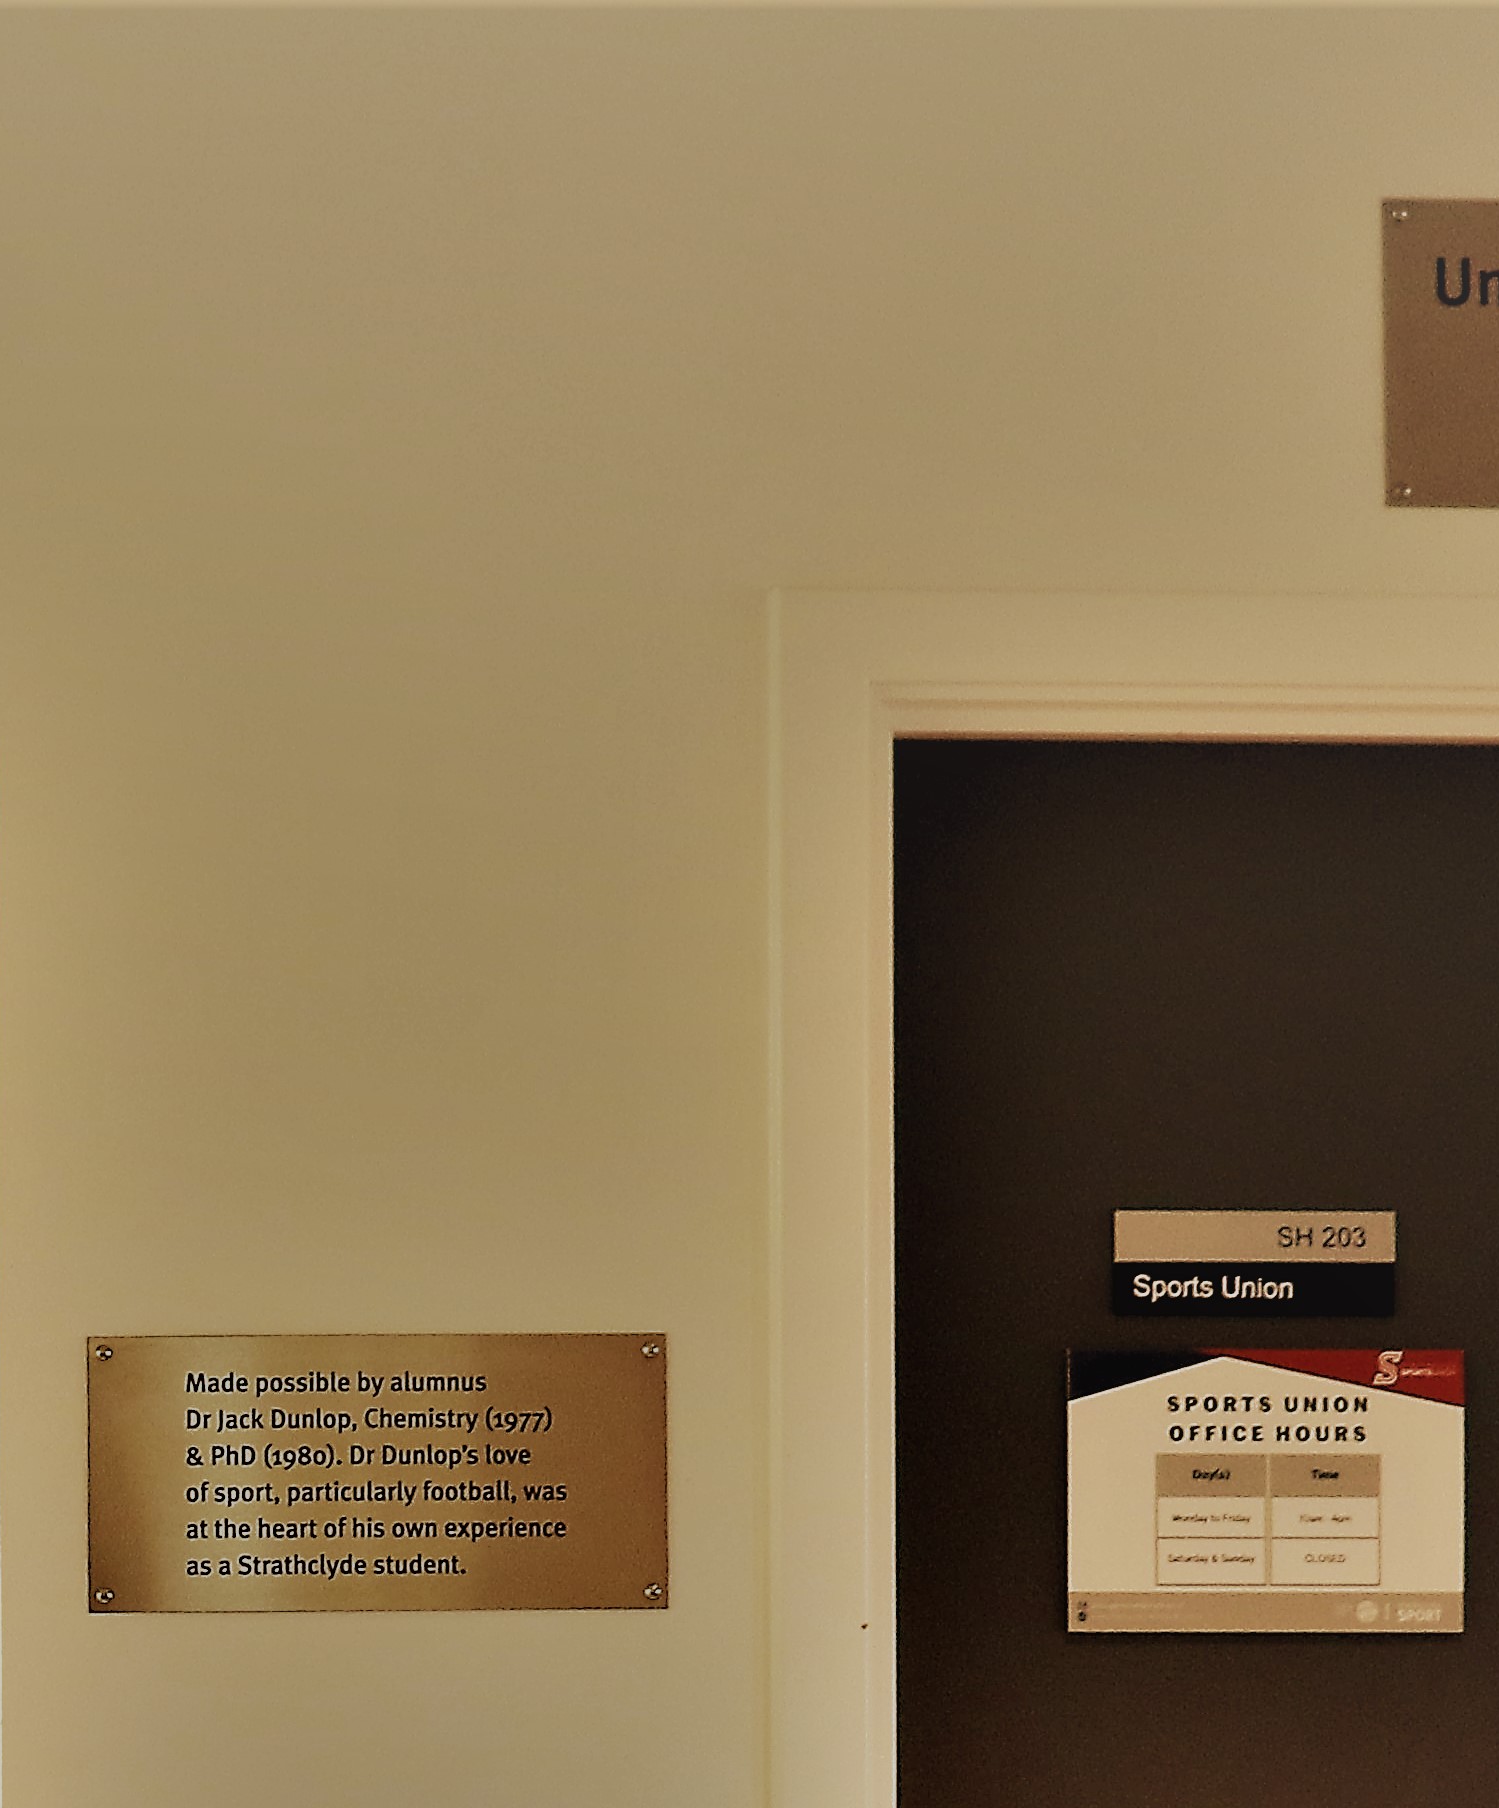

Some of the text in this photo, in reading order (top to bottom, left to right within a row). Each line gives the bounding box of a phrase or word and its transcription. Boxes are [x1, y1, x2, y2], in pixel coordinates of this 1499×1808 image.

[1278, 1227, 1365, 1247] SH 203
[1134, 1274, 1293, 1302] Sports Union
[186, 1371, 486, 1397] Made possible by alumnus
[1168, 1396, 1367, 1412] SPORTS UNION
[187, 1406, 552, 1434] Dr Jack Dunlop, Chemistry (1977)
[1170, 1426, 1365, 1441] OFFICE HOURS
[187, 1443, 530, 1470] & PhD (1980). Dr Dunlop's love
[187, 1480, 567, 1507] of sport, particularly football, was
[187, 1517, 566, 1542] at the heart of his own experience
[187, 1554, 466, 1580] as a Strathclyde student.
